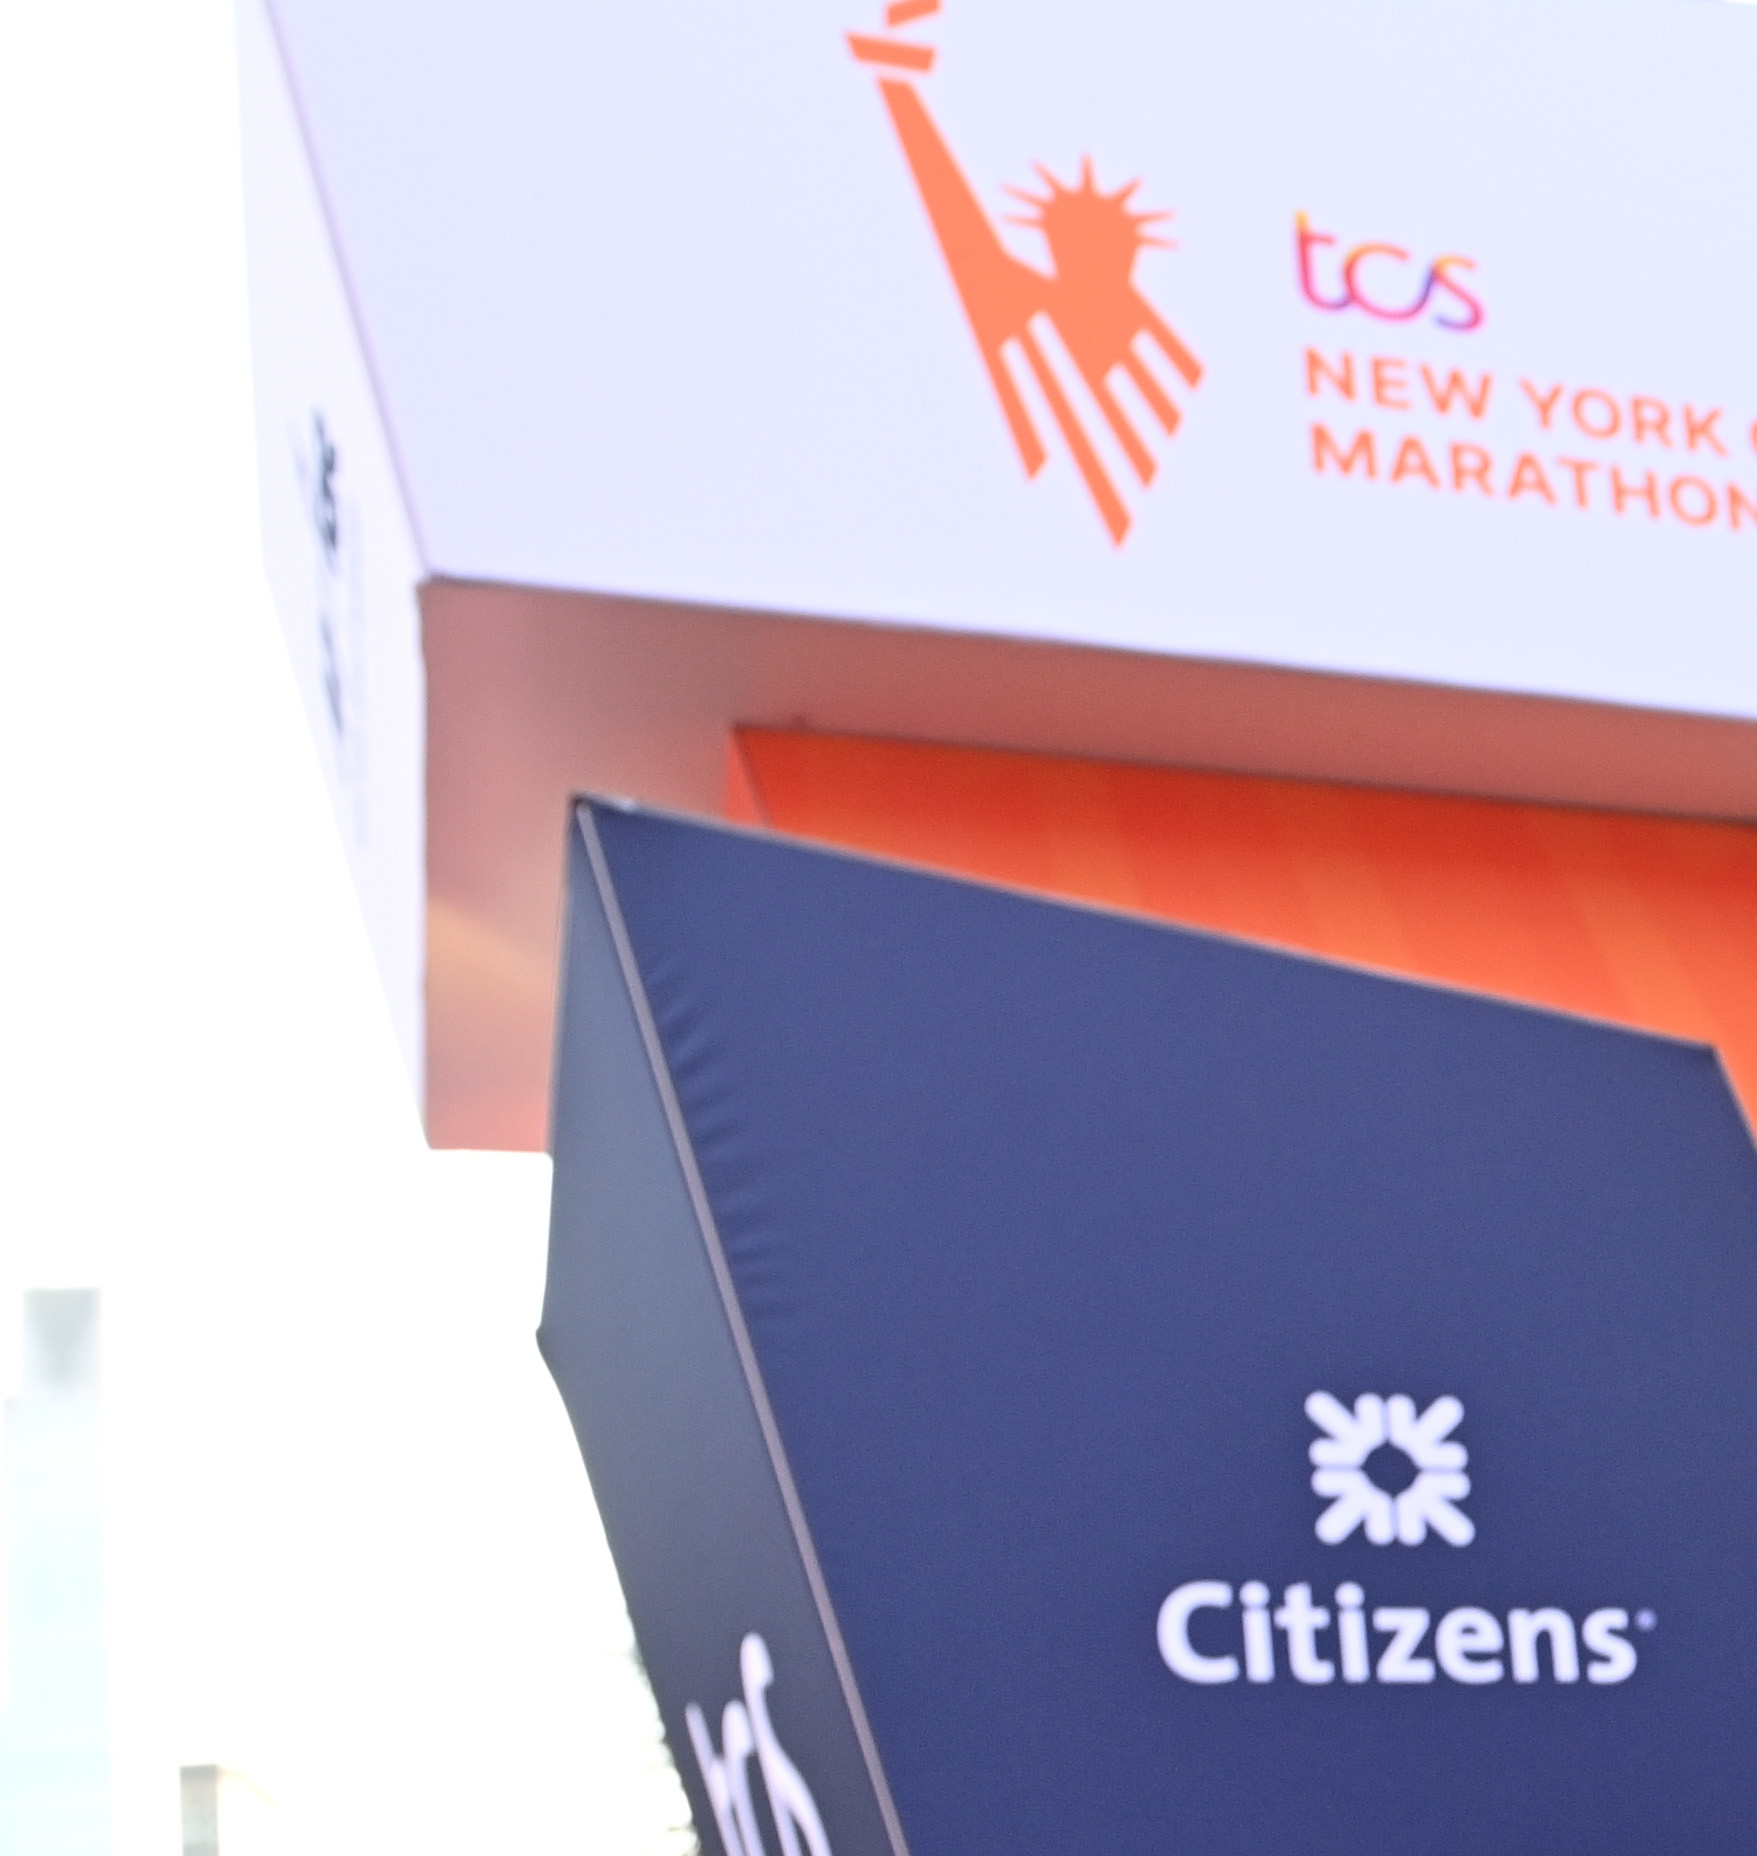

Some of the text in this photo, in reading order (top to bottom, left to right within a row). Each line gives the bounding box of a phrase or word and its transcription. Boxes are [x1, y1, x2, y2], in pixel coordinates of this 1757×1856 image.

[1293, 208, 1484, 332] tcs
[1303, 346, 1492, 421] NEW
[1519, 378, 1728, 457] YORK
[1157, 1579, 1640, 1685] Citizens
